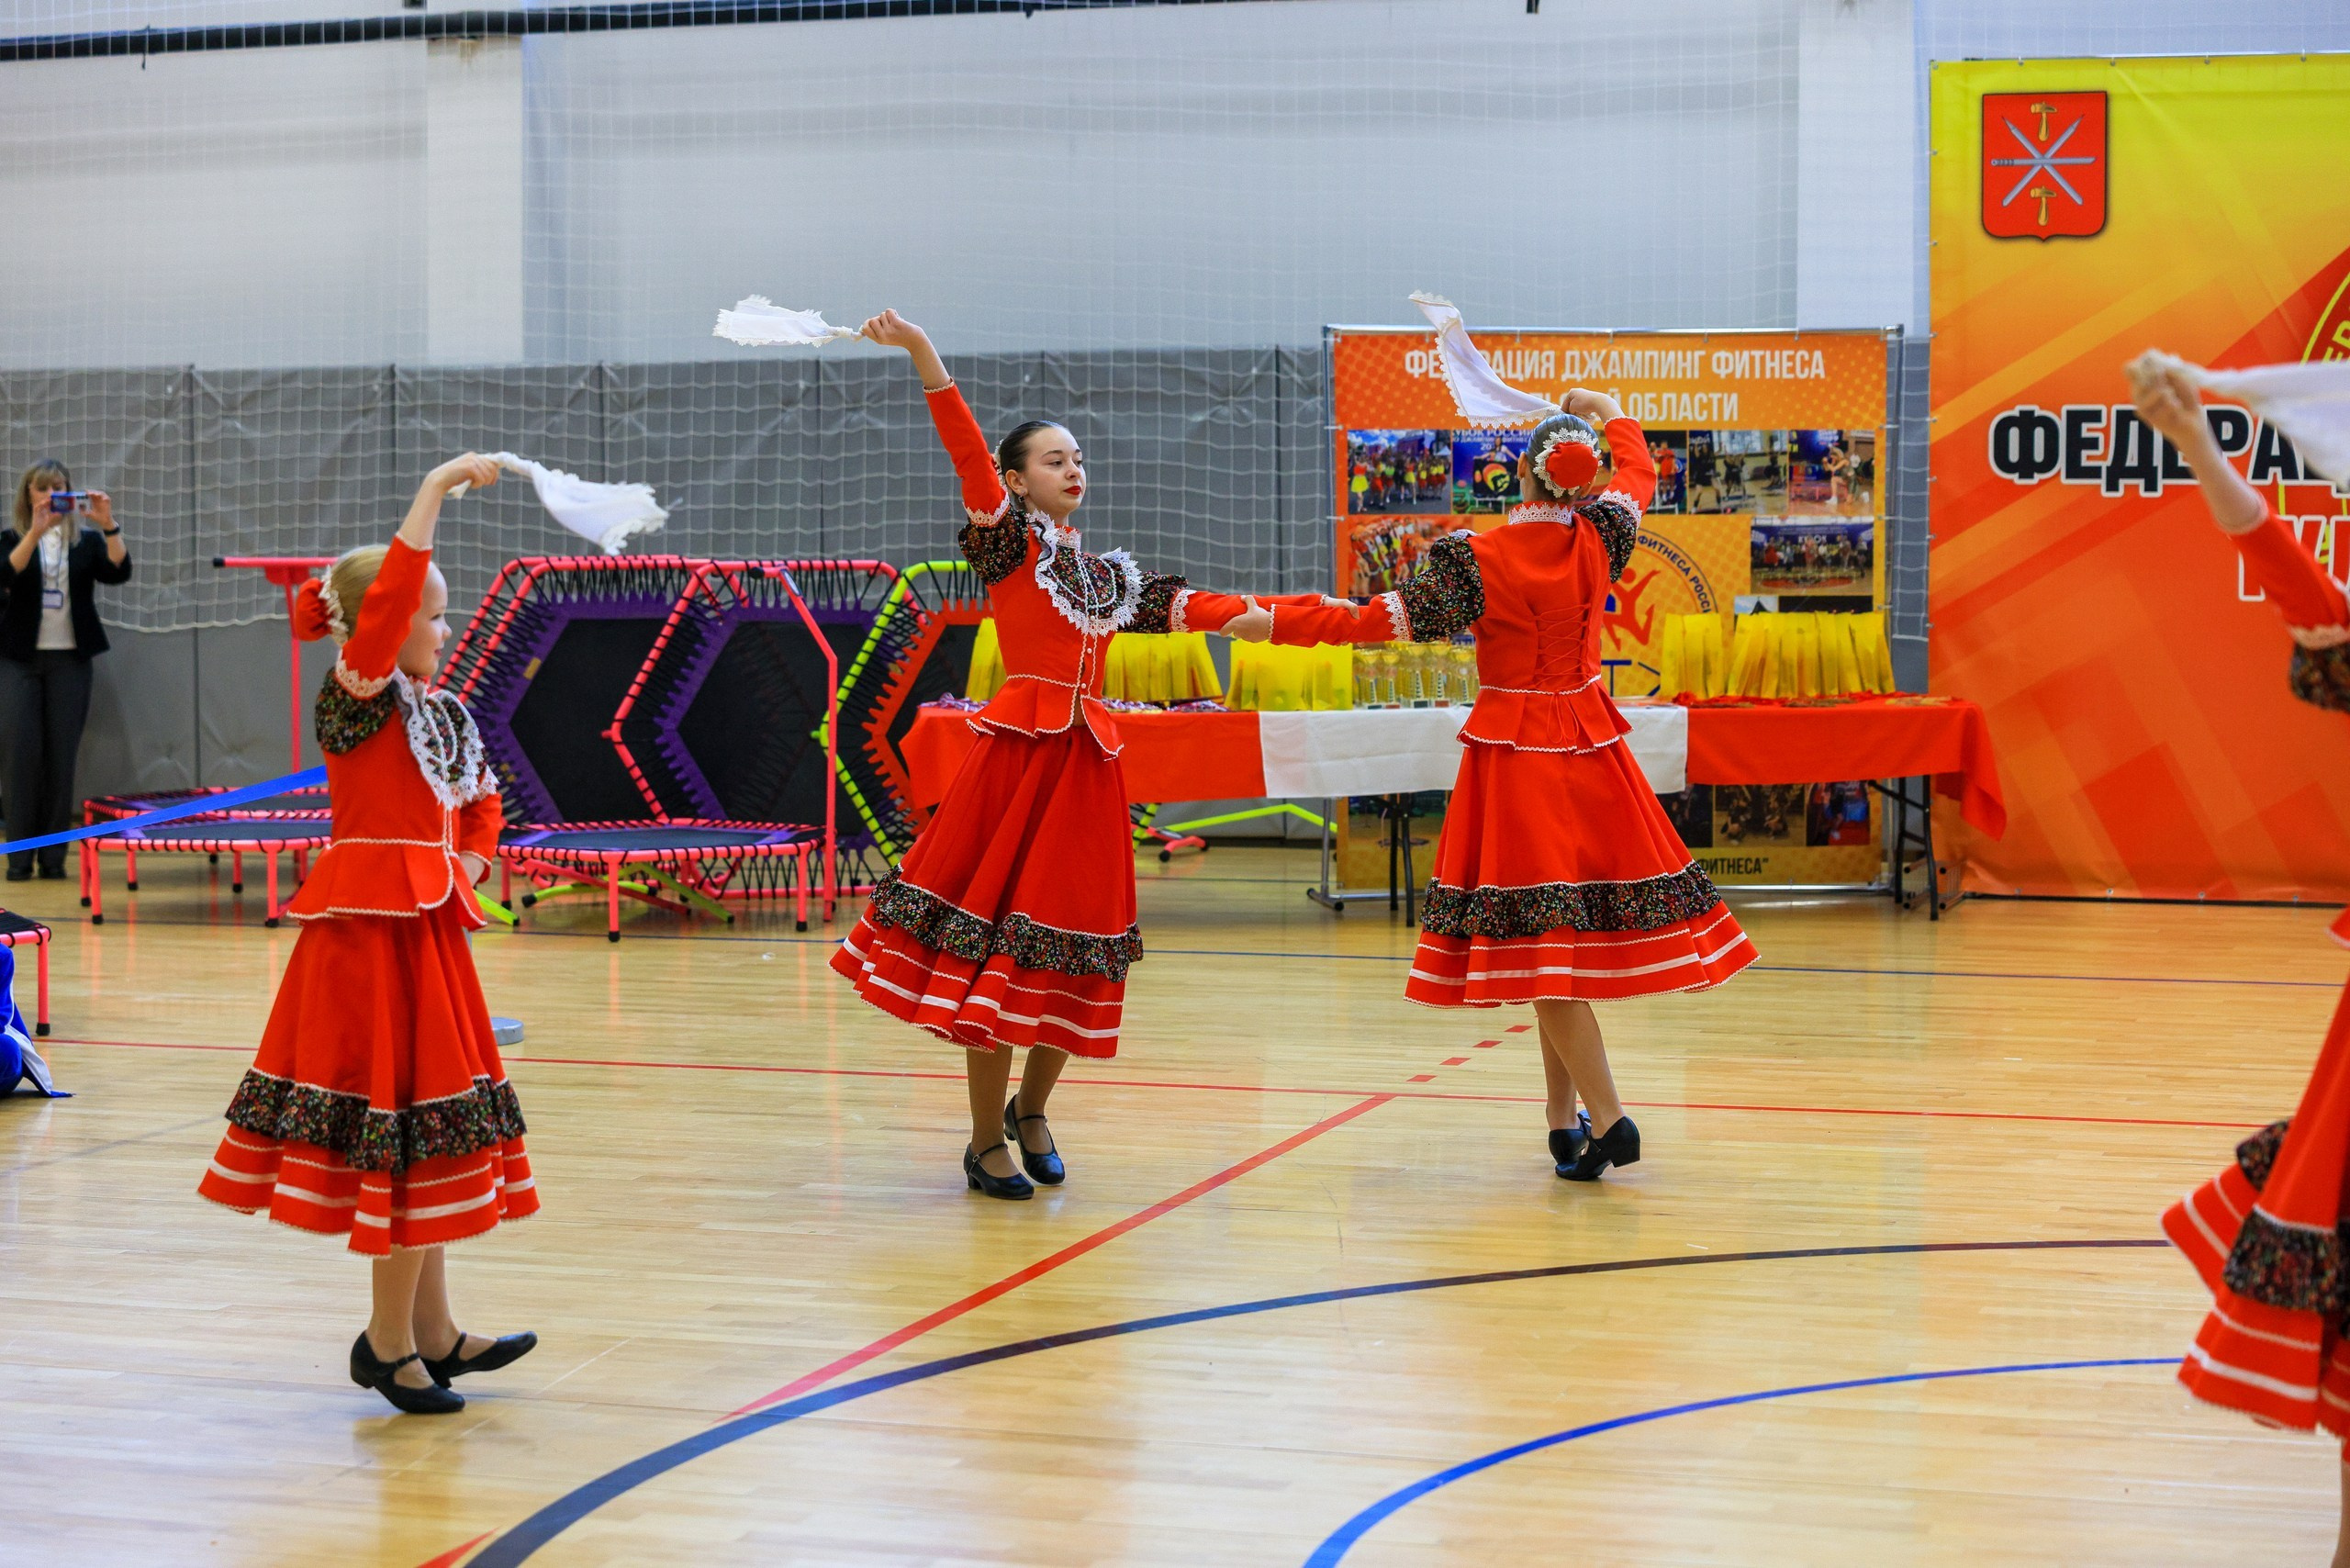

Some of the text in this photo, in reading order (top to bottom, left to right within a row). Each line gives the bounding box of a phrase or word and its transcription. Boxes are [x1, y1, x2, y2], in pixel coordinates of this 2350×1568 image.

[1561, 350, 1706, 381] ДЖАМПИНГ
[1711, 350, 1826, 379] ФИТНЕСА
[1628, 392, 1739, 422] ОБЛАСТИ
[1638, 535, 1692, 577] ФИТНЕСА
